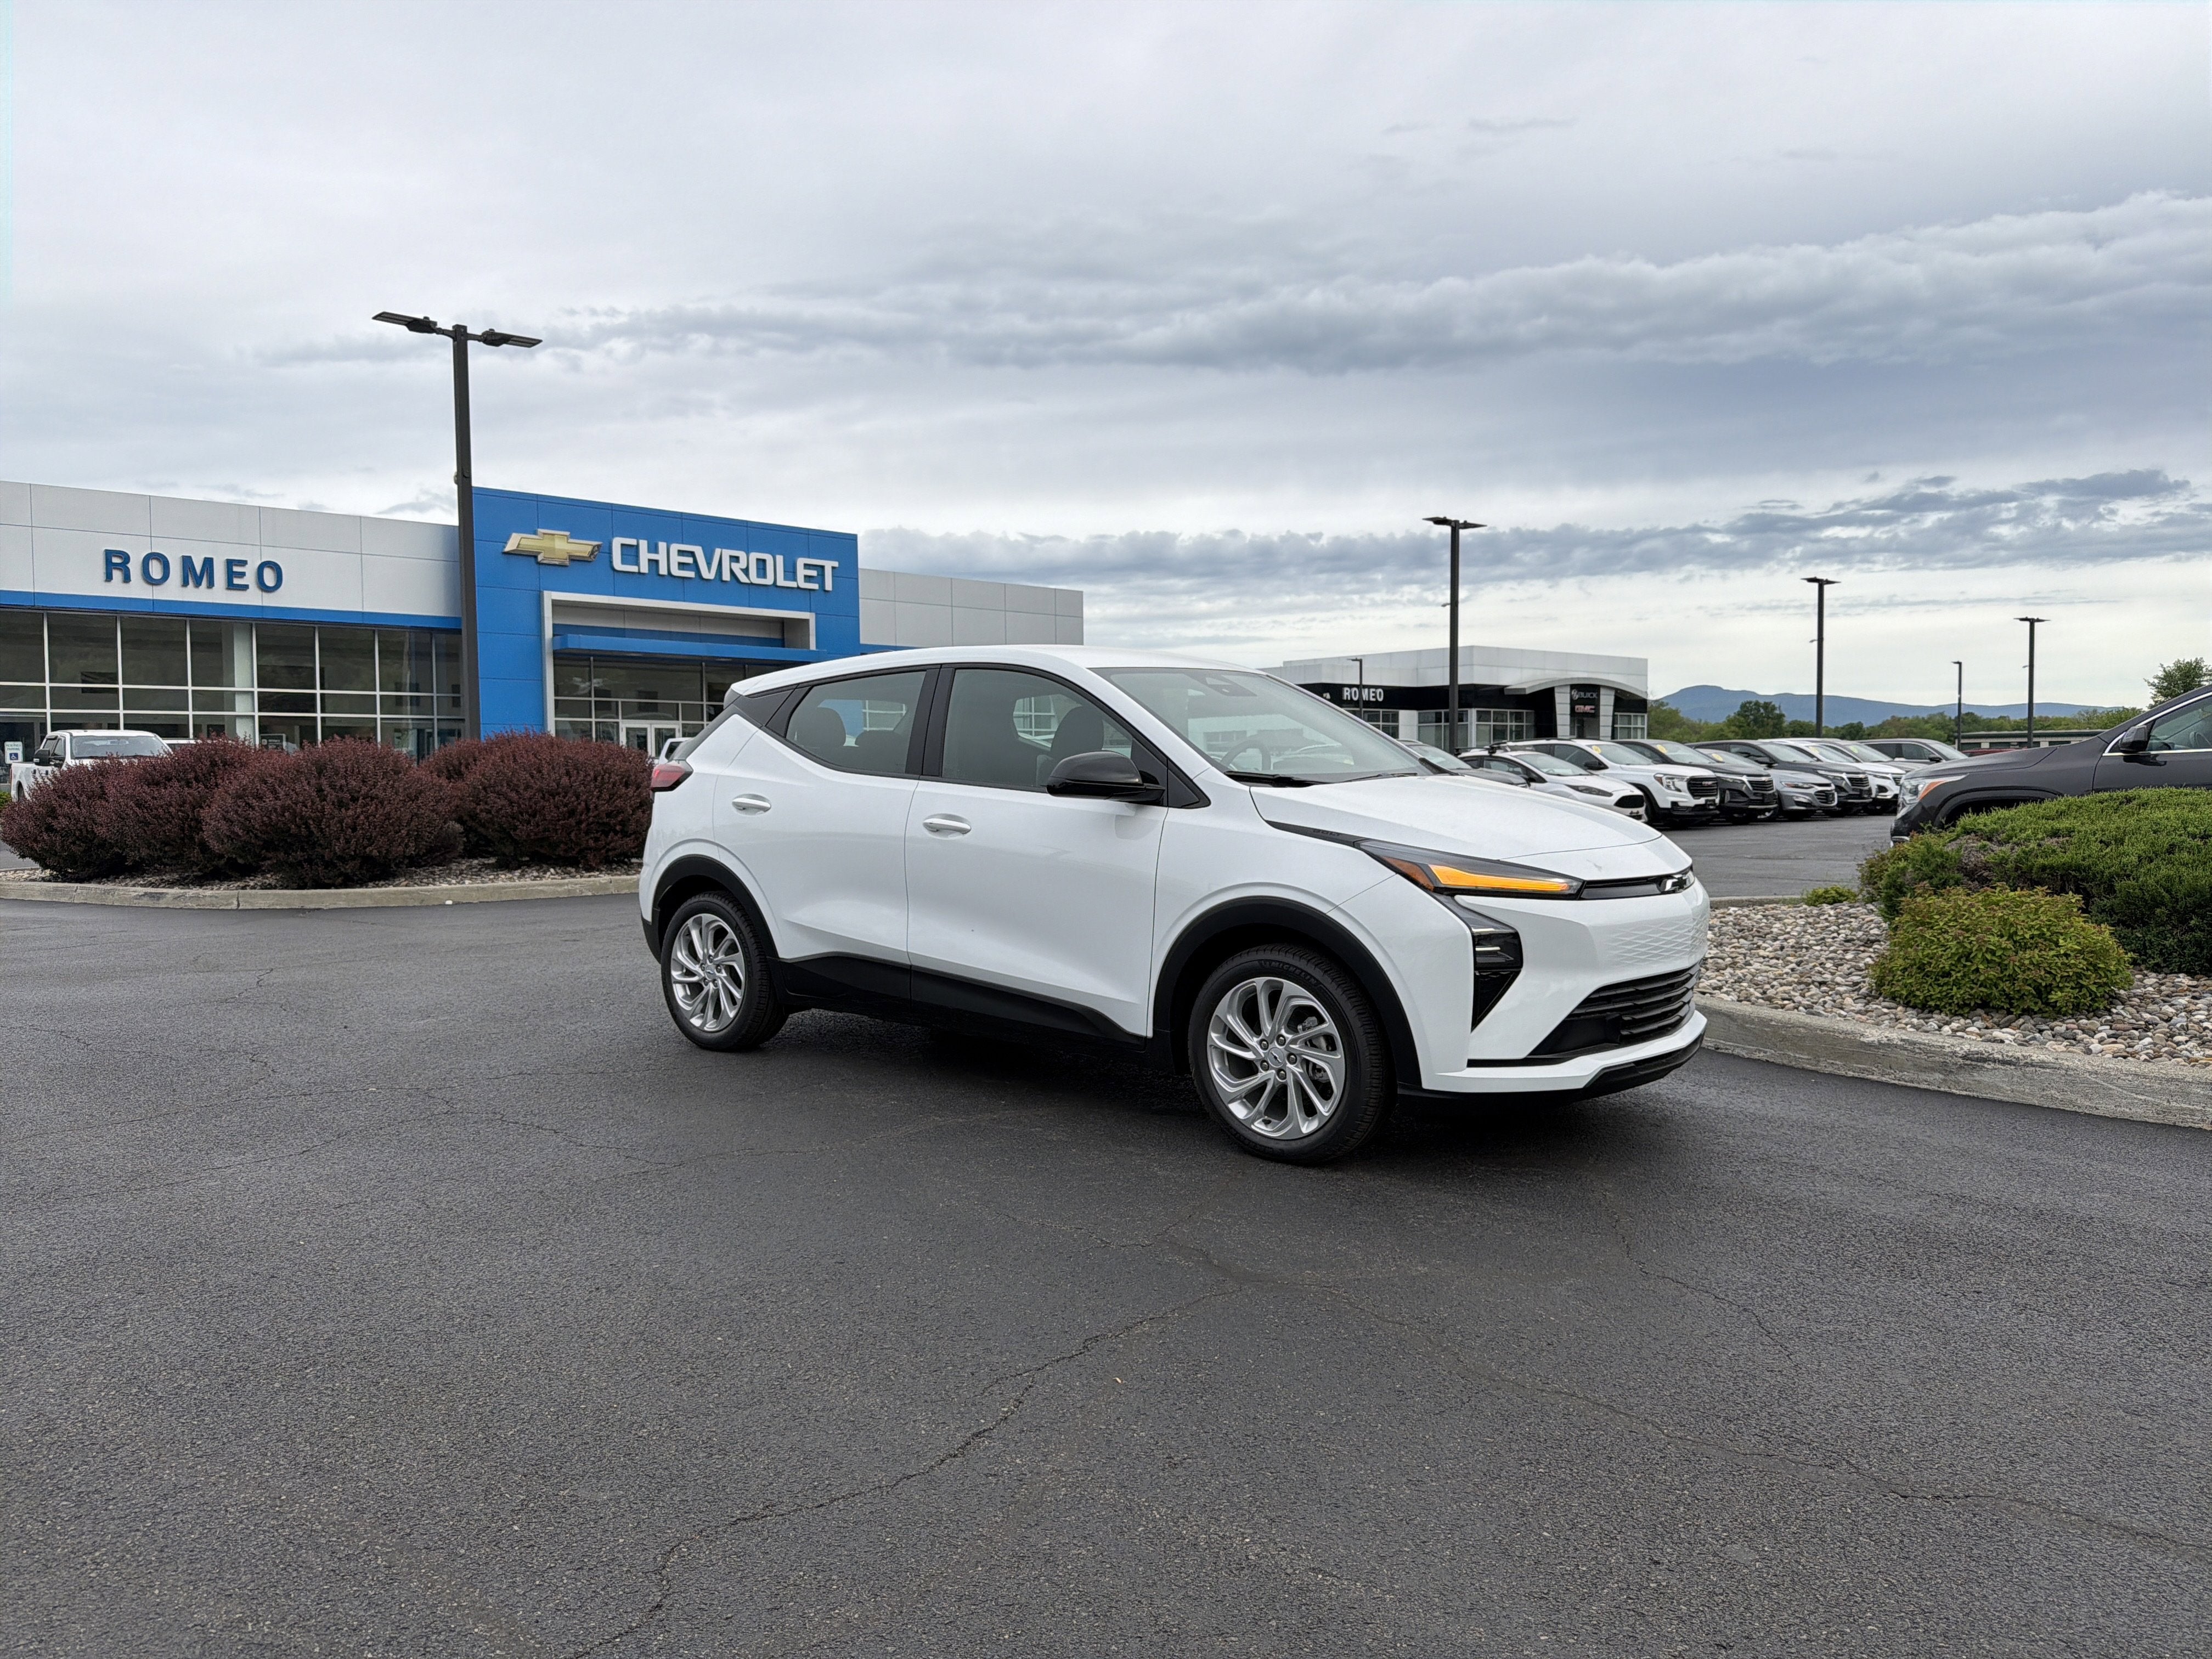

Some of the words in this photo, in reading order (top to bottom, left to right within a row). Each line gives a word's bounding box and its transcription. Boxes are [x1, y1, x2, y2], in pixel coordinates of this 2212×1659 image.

[103, 549, 283, 592] ROMEO
[612, 537, 839, 591] CHEVROLET
[1343, 687, 1384, 701] ROMEO
[1574, 704, 1595, 713] GMC
[1271, 961, 1317, 985] MICHELIN
